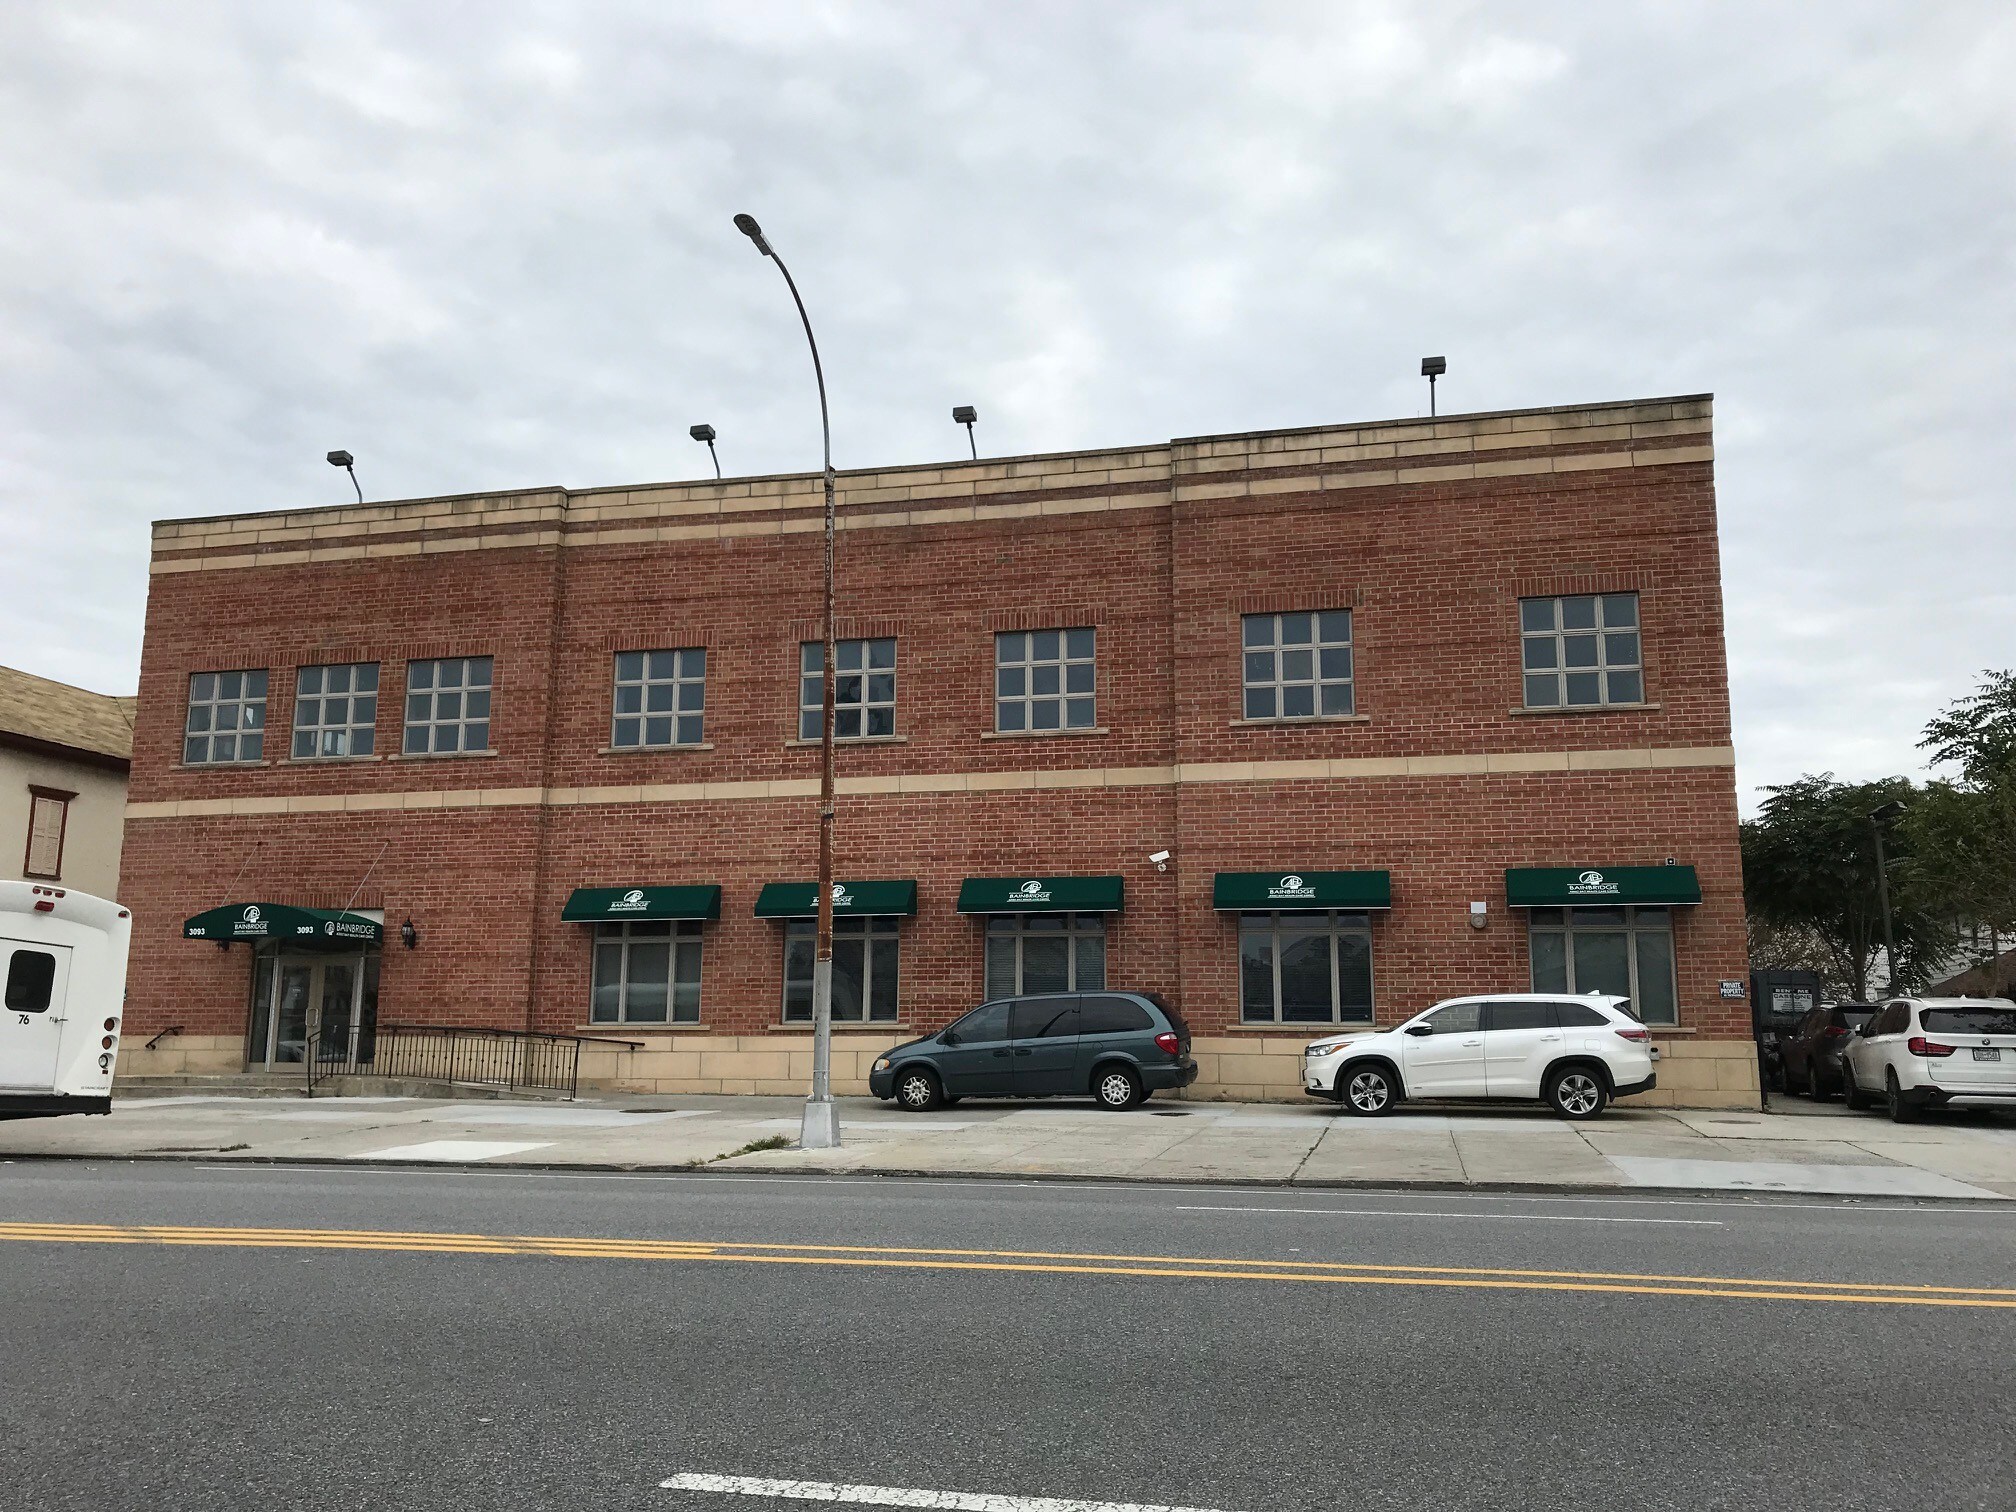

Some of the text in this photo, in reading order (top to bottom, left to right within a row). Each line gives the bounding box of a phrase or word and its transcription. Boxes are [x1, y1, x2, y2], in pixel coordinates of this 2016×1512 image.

[188, 928, 206, 936] 3093
[296, 926, 314, 934] 3093
[336, 922, 375, 935] BAINBRIDGE
[18, 1014, 30, 1025] 76
